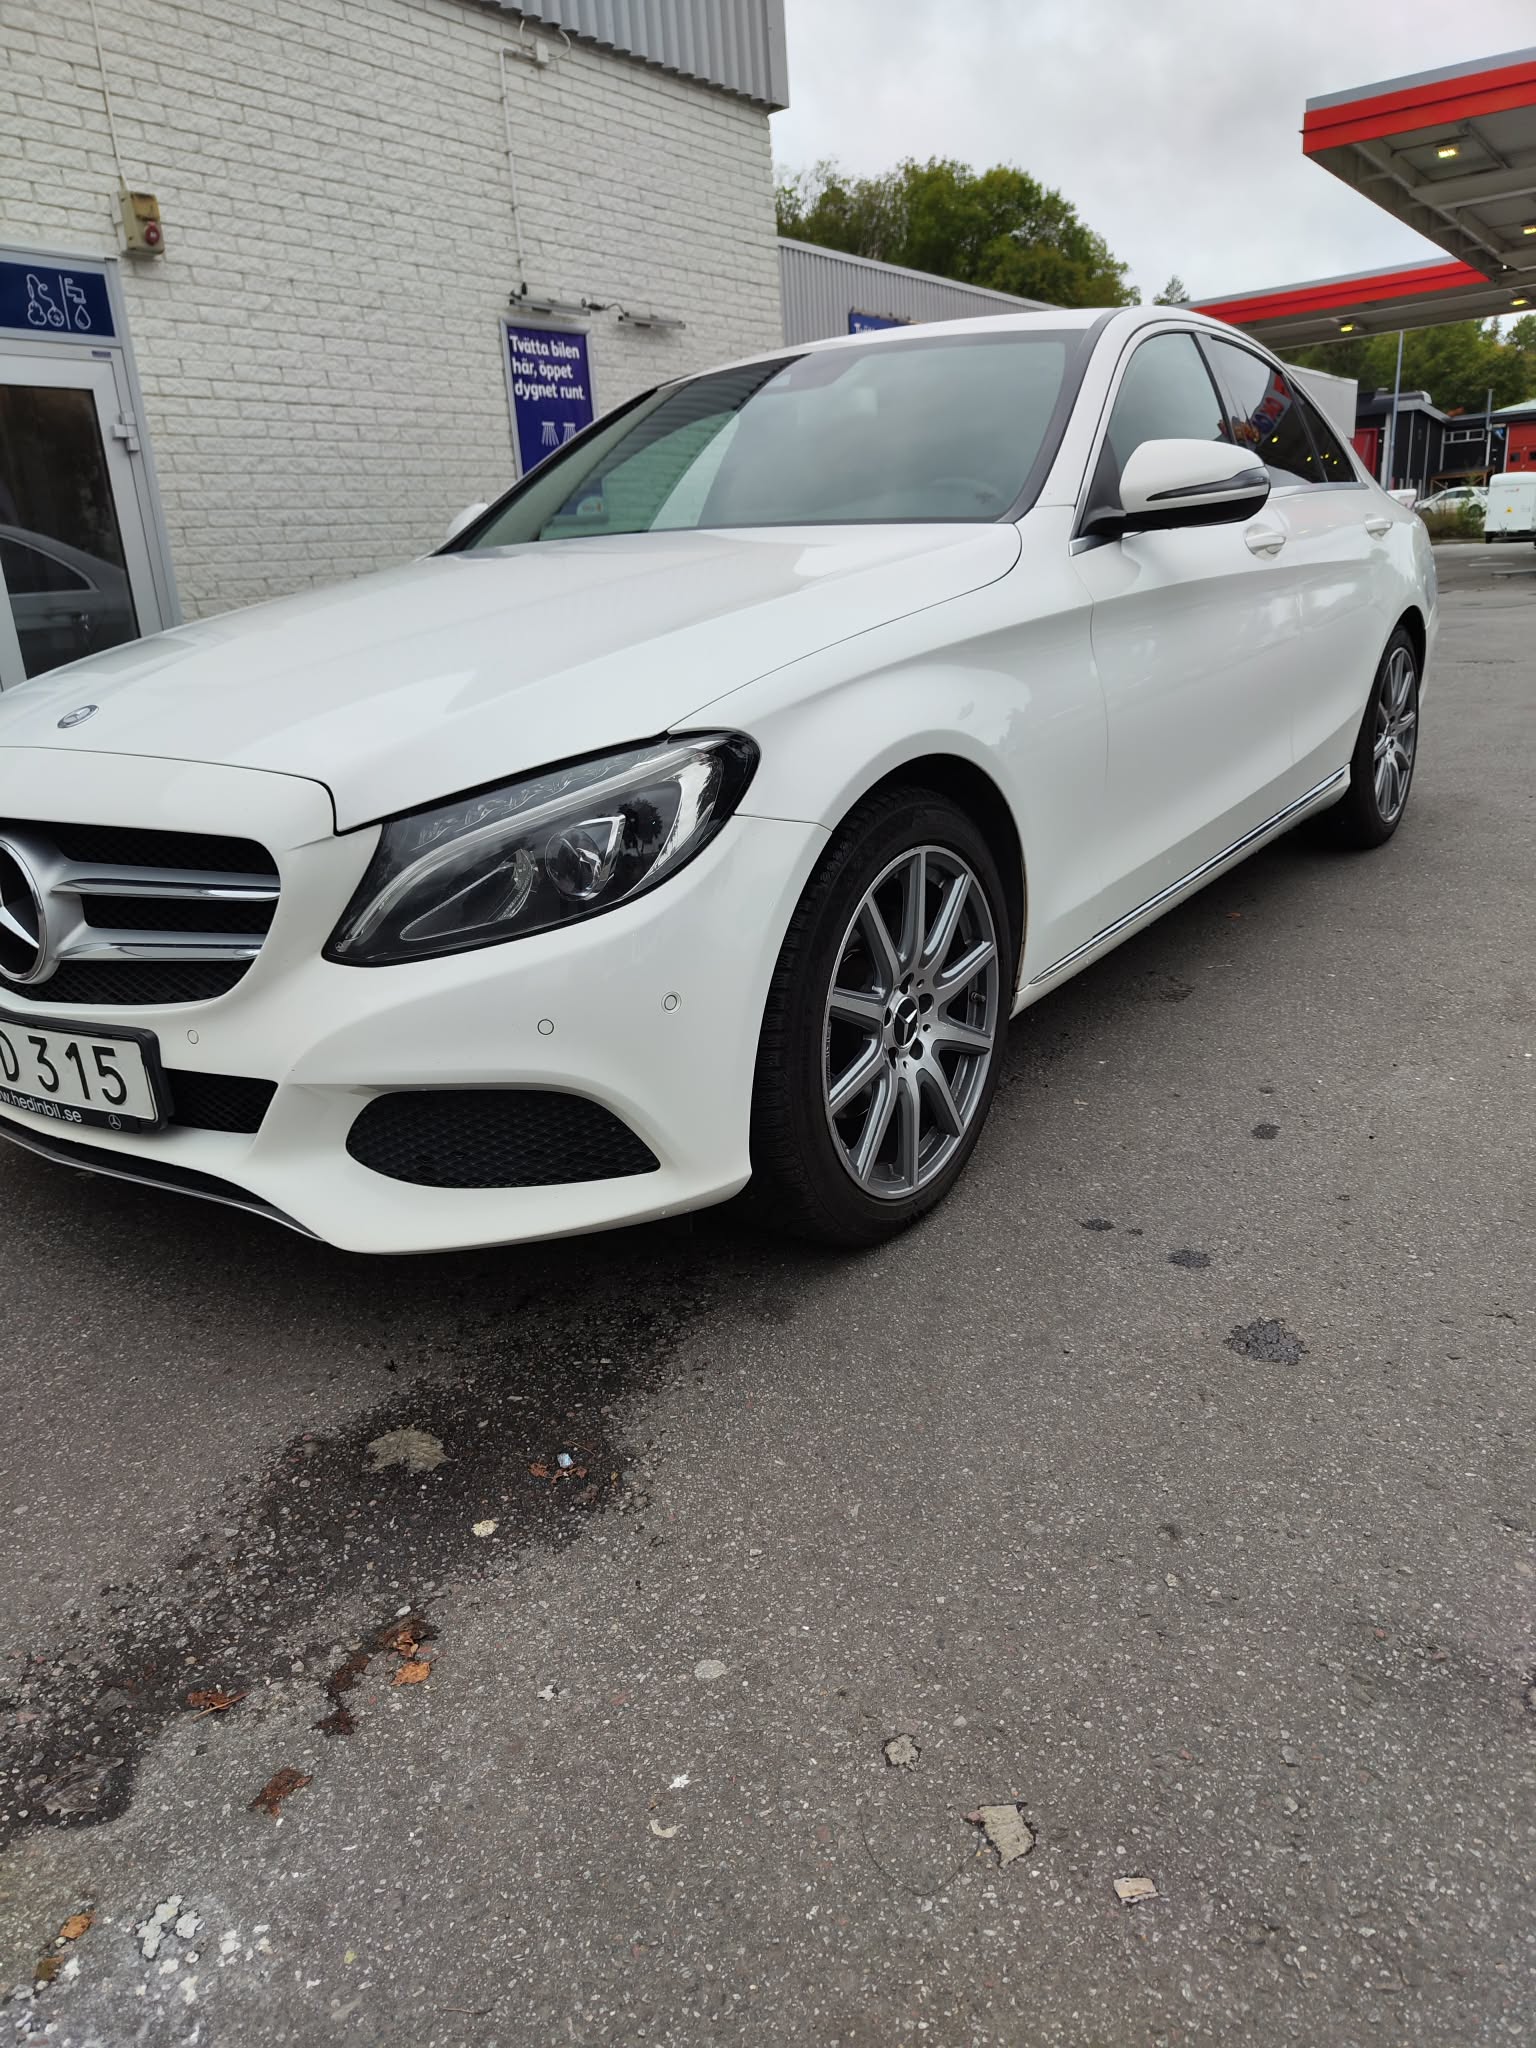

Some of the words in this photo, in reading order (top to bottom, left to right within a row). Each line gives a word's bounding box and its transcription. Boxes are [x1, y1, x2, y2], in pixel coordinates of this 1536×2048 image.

[509, 335, 550, 356] Tvätta
[551, 340, 580, 360] bilen
[512, 357, 537, 378] här,
[539, 360, 573, 382] öppet
[514, 378, 557, 401] dygnet
[27, 1035, 127, 1105] 315
